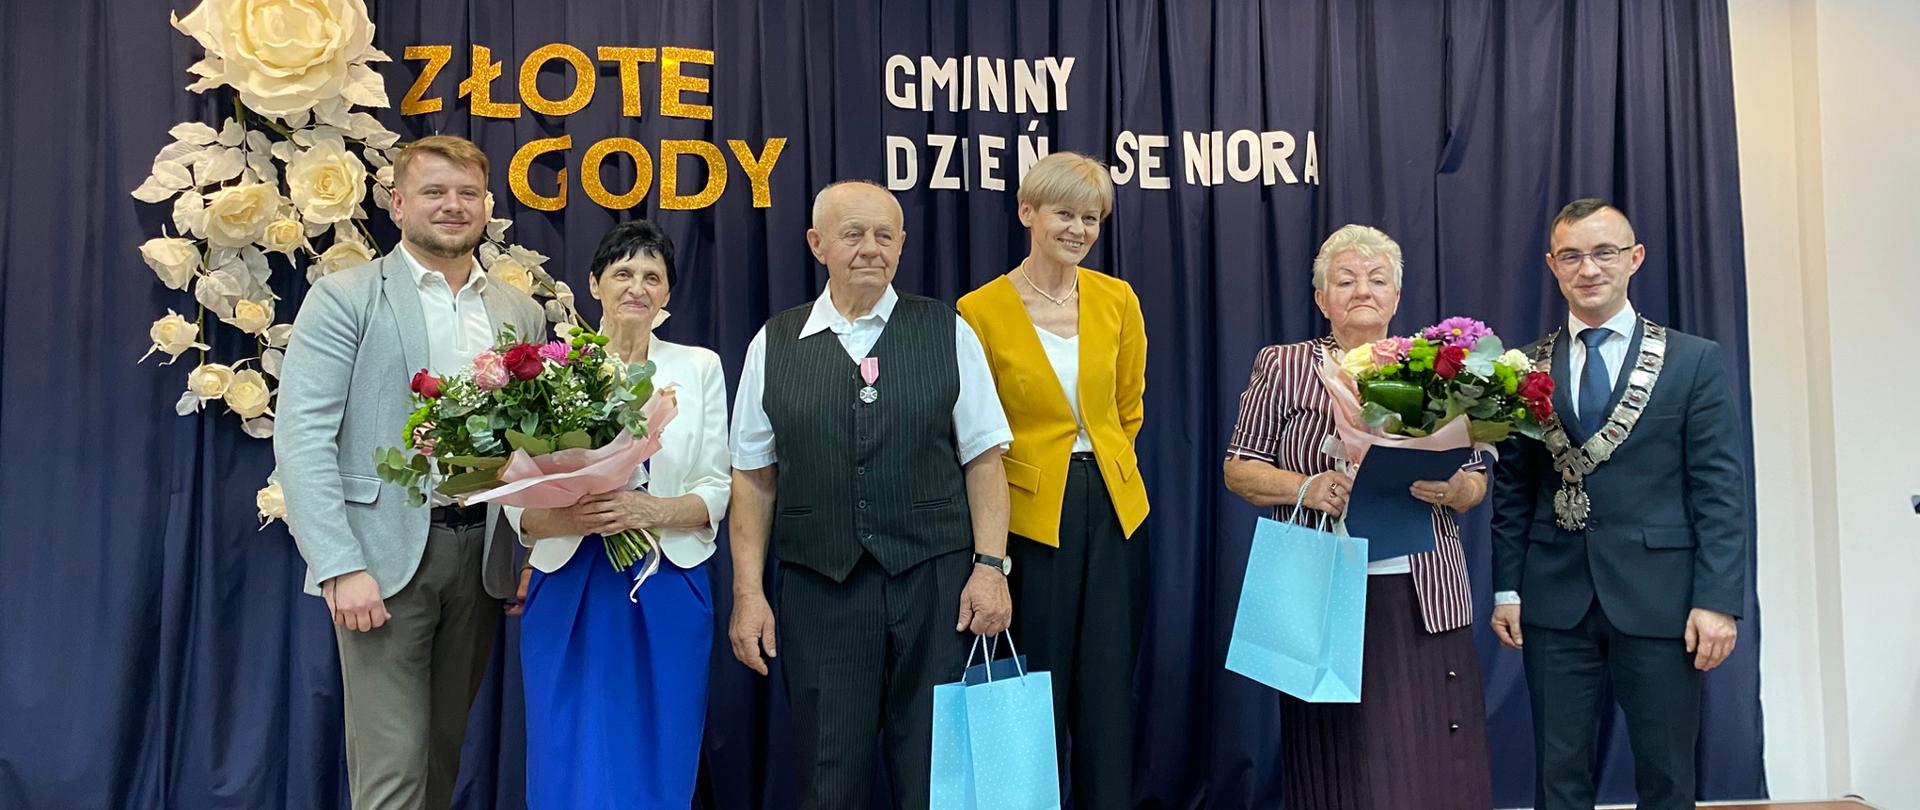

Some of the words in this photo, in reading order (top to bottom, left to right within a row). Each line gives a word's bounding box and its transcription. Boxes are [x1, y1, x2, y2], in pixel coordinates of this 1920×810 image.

[401, 43, 714, 120] ZŁOTE
[885, 54, 1075, 113] GMINNY
[508, 134, 788, 211] GODY
[886, 120, 1049, 191] DZIEŃ
